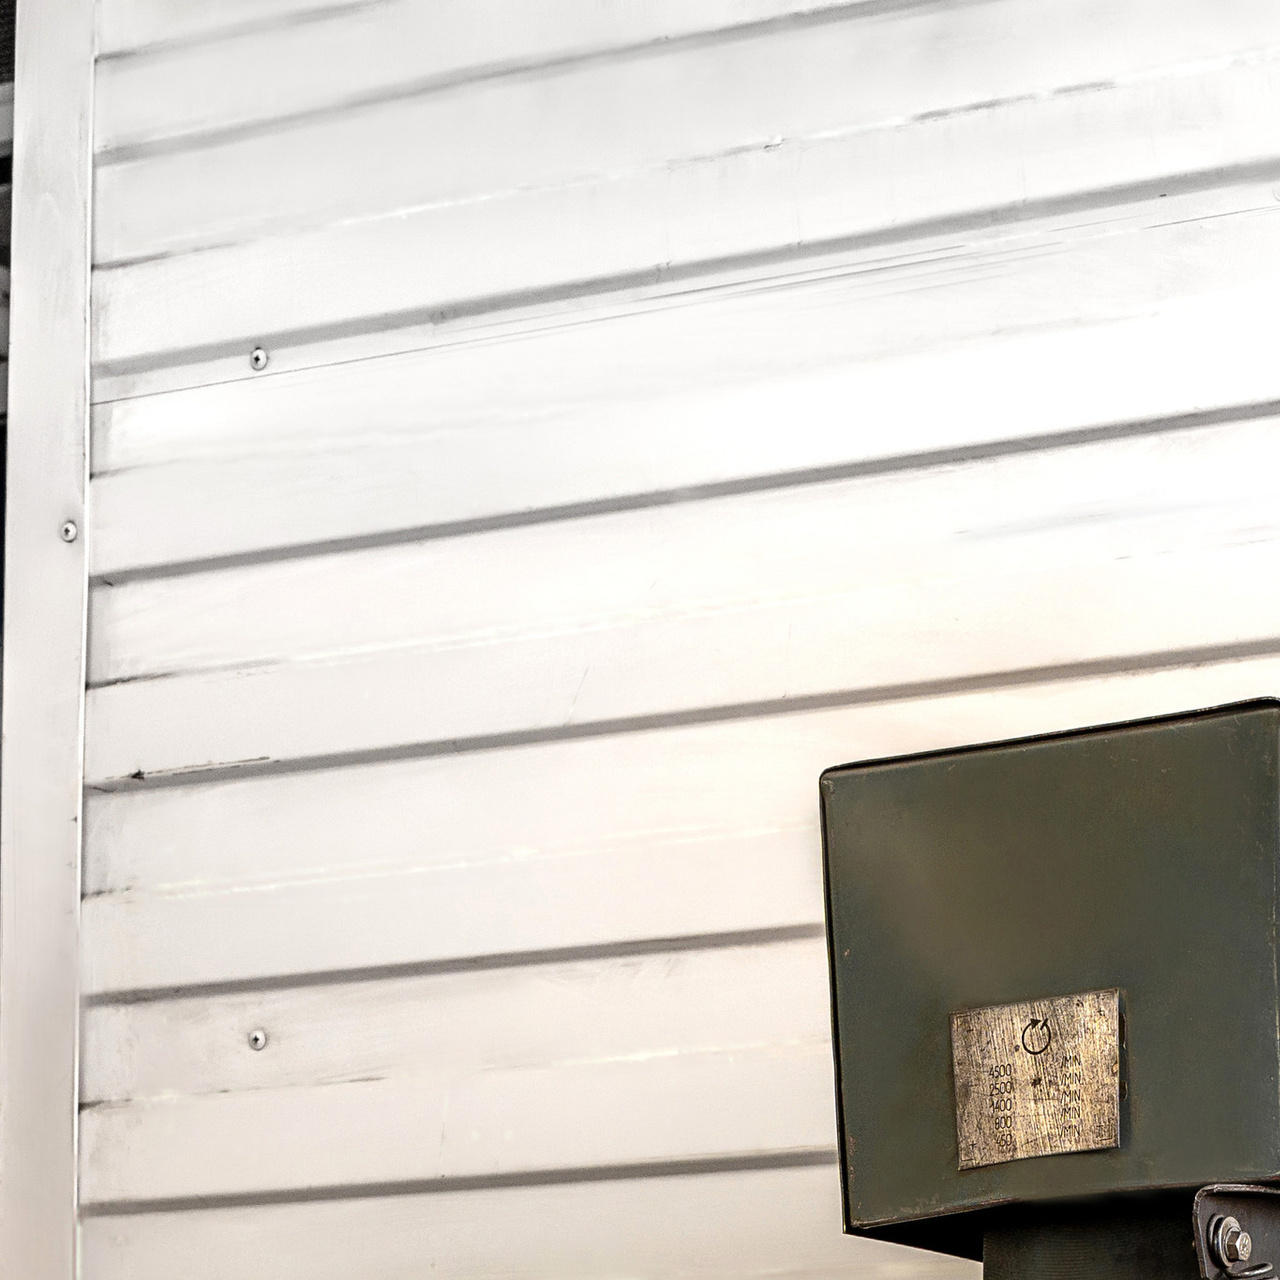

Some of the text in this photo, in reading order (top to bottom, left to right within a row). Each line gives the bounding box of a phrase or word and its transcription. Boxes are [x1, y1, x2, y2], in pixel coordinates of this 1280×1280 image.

[989, 1063, 1012, 1079] 4500
[989, 1081, 1012, 1096] 2500
[994, 1116, 1012, 1130] 800
